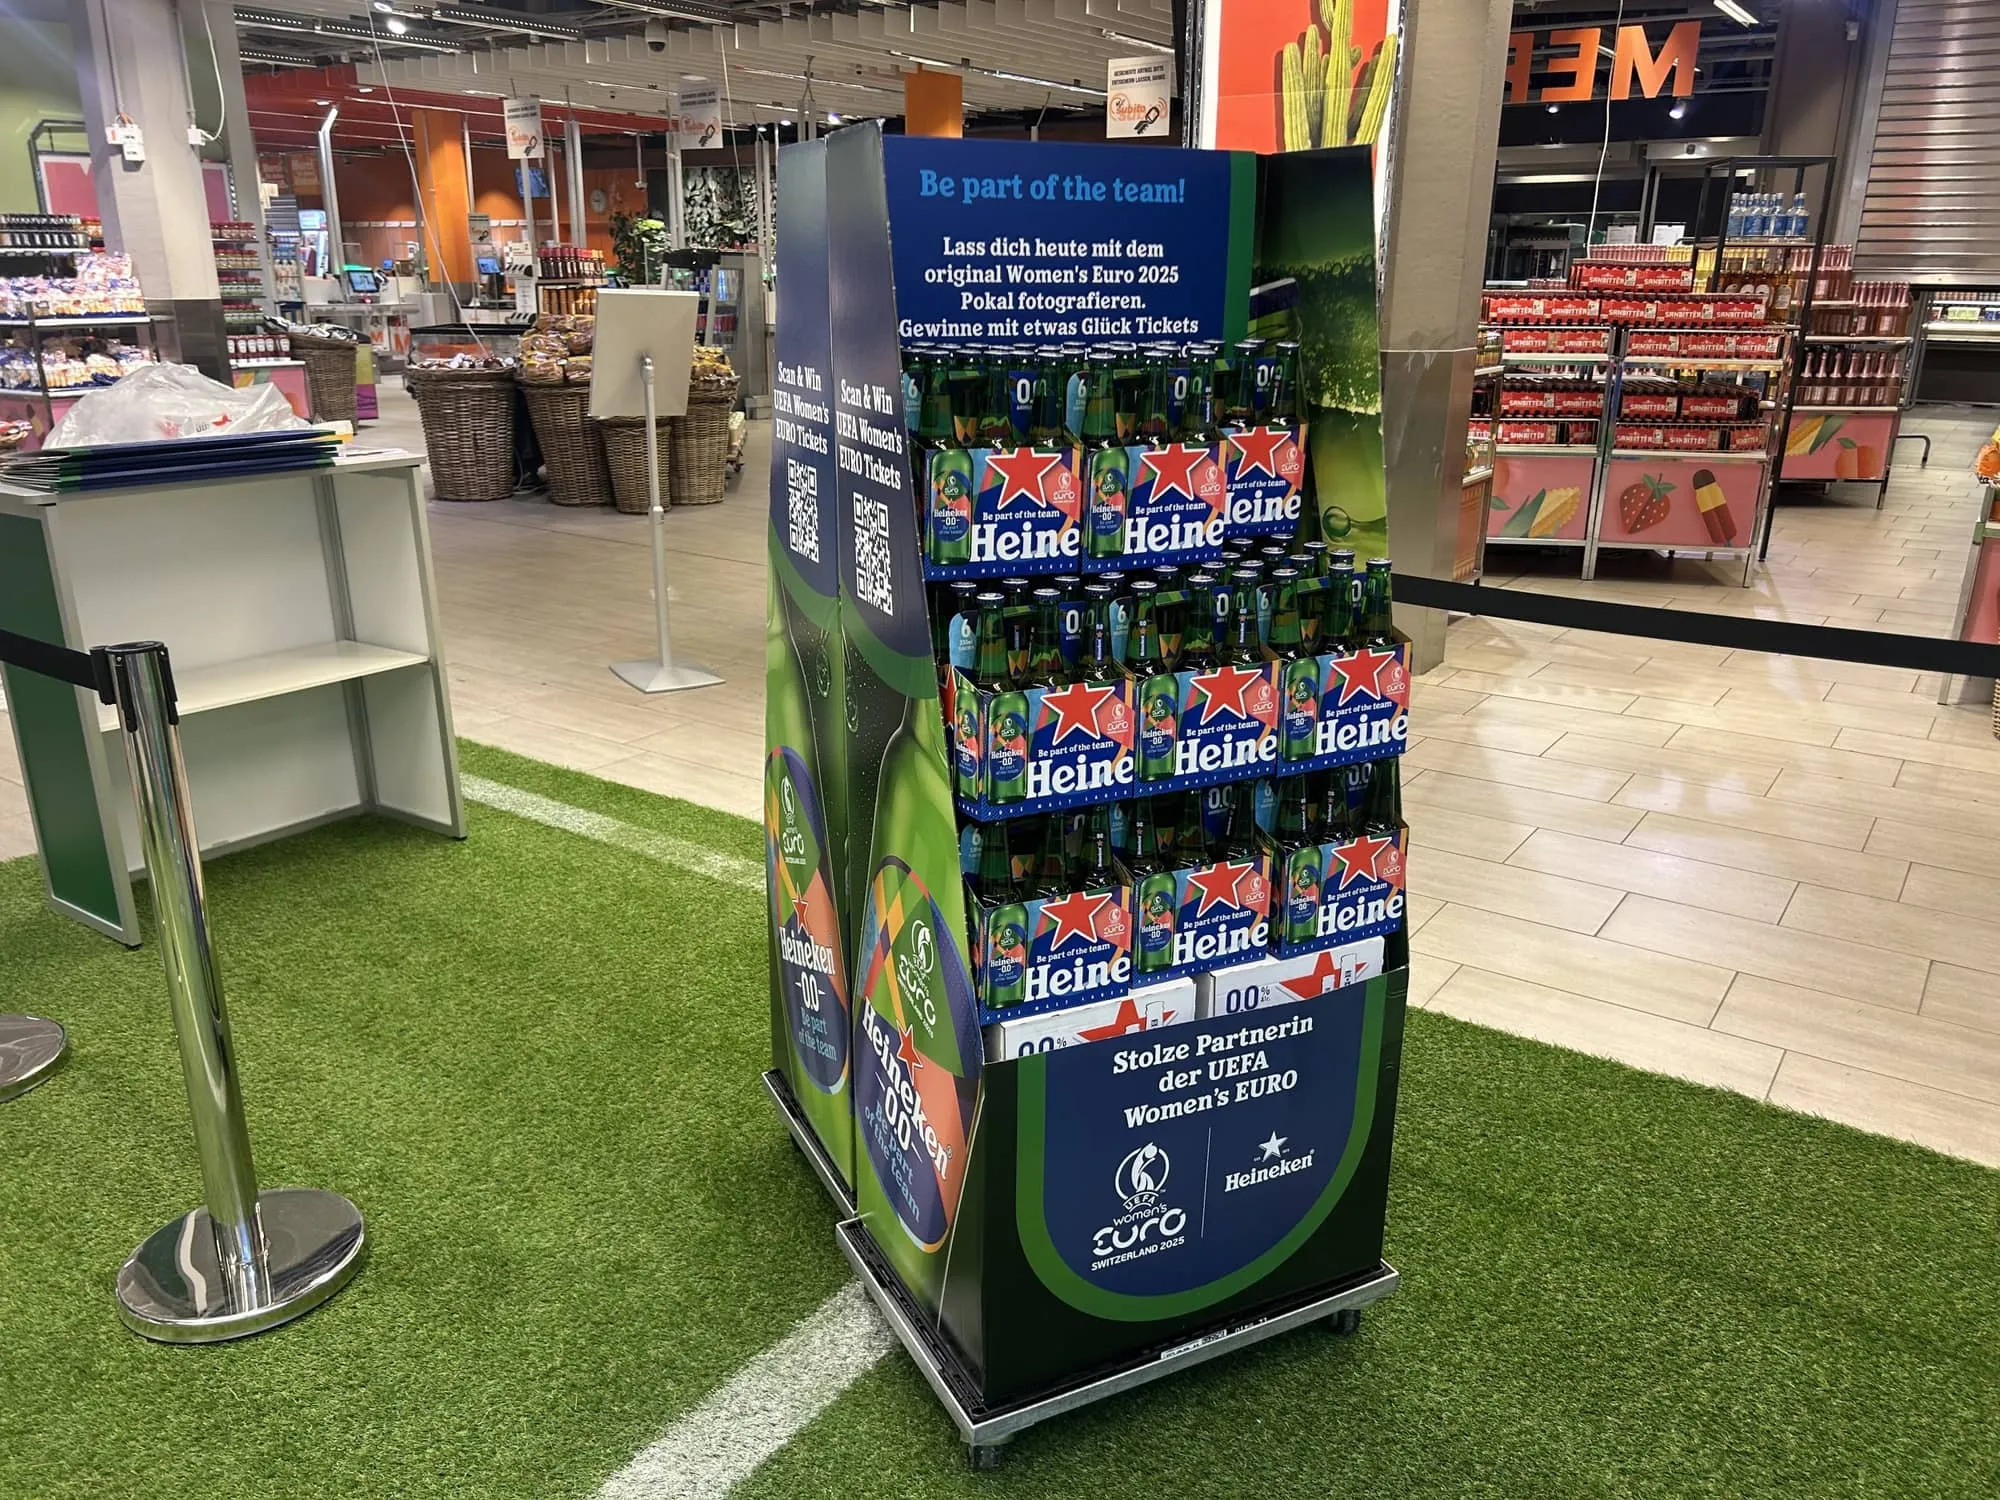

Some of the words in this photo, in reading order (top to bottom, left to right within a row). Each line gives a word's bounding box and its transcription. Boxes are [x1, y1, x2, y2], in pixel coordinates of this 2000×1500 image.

[920, 169, 954, 197] Be
[962, 175, 1022, 204] part
[1030, 175, 1058, 200] of
[1063, 176, 1106, 202] the
[1112, 178, 1186, 203] team!
[943, 237, 985, 256] Lass
[990, 238, 1033, 257] dich
[1038, 238, 1087, 257] heute
[1091, 239, 1122, 257] mit
[1126, 239, 1164, 258] dem
[925, 264, 1001, 286] original
[1007, 265, 1088, 284] Women's
[1093, 266, 1134, 283] Euro
[1138, 266, 1179, 282] 2025
[961, 292, 1013, 310] Pokal
[1018, 292, 1146, 313] fotografieren.
[900, 319, 983, 337] Gewinne
[987, 319, 1019, 336] mit
[1023, 320, 1077, 336] etwas
[1081, 318, 1131, 335] Glück
[1136, 317, 1198, 334] Tickets
[778, 362, 796, 384] Scan
[796, 364, 803, 386] &
[803, 366, 822, 392] Win
[840, 379, 862, 405] Scan
[863, 383, 871, 410] &
[872, 384, 893, 415] Win
[908, 378, 917, 398] 6
[1078, 379, 1086, 397] 6
[774, 389, 792, 412] UEFA
[793, 396, 829, 424] Women's
[776, 418, 796, 443] EURO
[797, 424, 828, 455] Tickets
[836, 411, 858, 440] UEFA
[859, 419, 902, 455] Women's
[839, 445, 862, 475] EURO
[864, 453, 901, 490] Tickets
[1232, 482, 1247, 491] part
[983, 512, 993, 520] Be
[995, 511, 1013, 520] part
[1015, 510, 1023, 519] of
[1024, 510, 1036, 518] the
[1136, 506, 1144, 514] Be
[1146, 505, 1163, 515] part
[1164, 504, 1173, 512] of
[1173, 503, 1184, 511] the
[1186, 502, 1206, 510] team
[1260, 591, 1270, 610] 6
[1118, 605, 1126, 623] 6
[962, 618, 970, 638] 6
[1326, 710, 1334, 718] Be
[1336, 708, 1352, 718] part
[1353, 705, 1361, 713] of
[1373, 701, 1392, 710] team
[1198, 727, 1214, 737] part
[1216, 724, 1225, 733] of
[1038, 749, 1048, 757] Be
[1050, 747, 1068, 758] part
[1069, 745, 1079, 754] of
[1079, 744, 1091, 752] the
[1092, 741, 1114, 749] team
[1264, 781, 1272, 796] 6
[1114, 803, 1122, 820] 6
[972, 828, 980, 846] 6
[1328, 894, 1336, 902] Be
[1337, 891, 1351, 902] part
[1370, 883, 1387, 892] team
[1184, 921, 1193, 930] Be
[1194, 918, 1210, 930] part
[1212, 915, 1220, 924] of
[1220, 913, 1231, 921] the
[1232, 910, 1251, 919] team
[778, 926, 836, 975] Heineken
[1048, 952, 1065, 963] part
[1067, 949, 1076, 958] of
[1076, 948, 1088, 956] the
[1089, 943, 1110, 952] team
[802, 971, 819, 1012] 0.0
[811, 1015, 828, 1036] part
[817, 1039, 837, 1062] team
[1113, 1043, 1190, 1074] Stolze
[1196, 1016, 1313, 1056] Partnerin
[1159, 1069, 1201, 1092] der
[1208, 1050, 1269, 1081] UEFA
[862, 997, 948, 1180] Heineken
[1234, 1070, 1298, 1103] EURO
[885, 1086, 911, 1151] 0.0
[888, 1133, 914, 1185] part
[874, 1123, 890, 1159] the
[890, 1157, 920, 1224] team
[1224, 1155, 1313, 1192] Heineken
[1123, 1194, 1156, 1211] UEFA
[1091, 1244, 1158, 1271] SWITZERLAND
[1160, 1236, 1185, 1250] 2025
